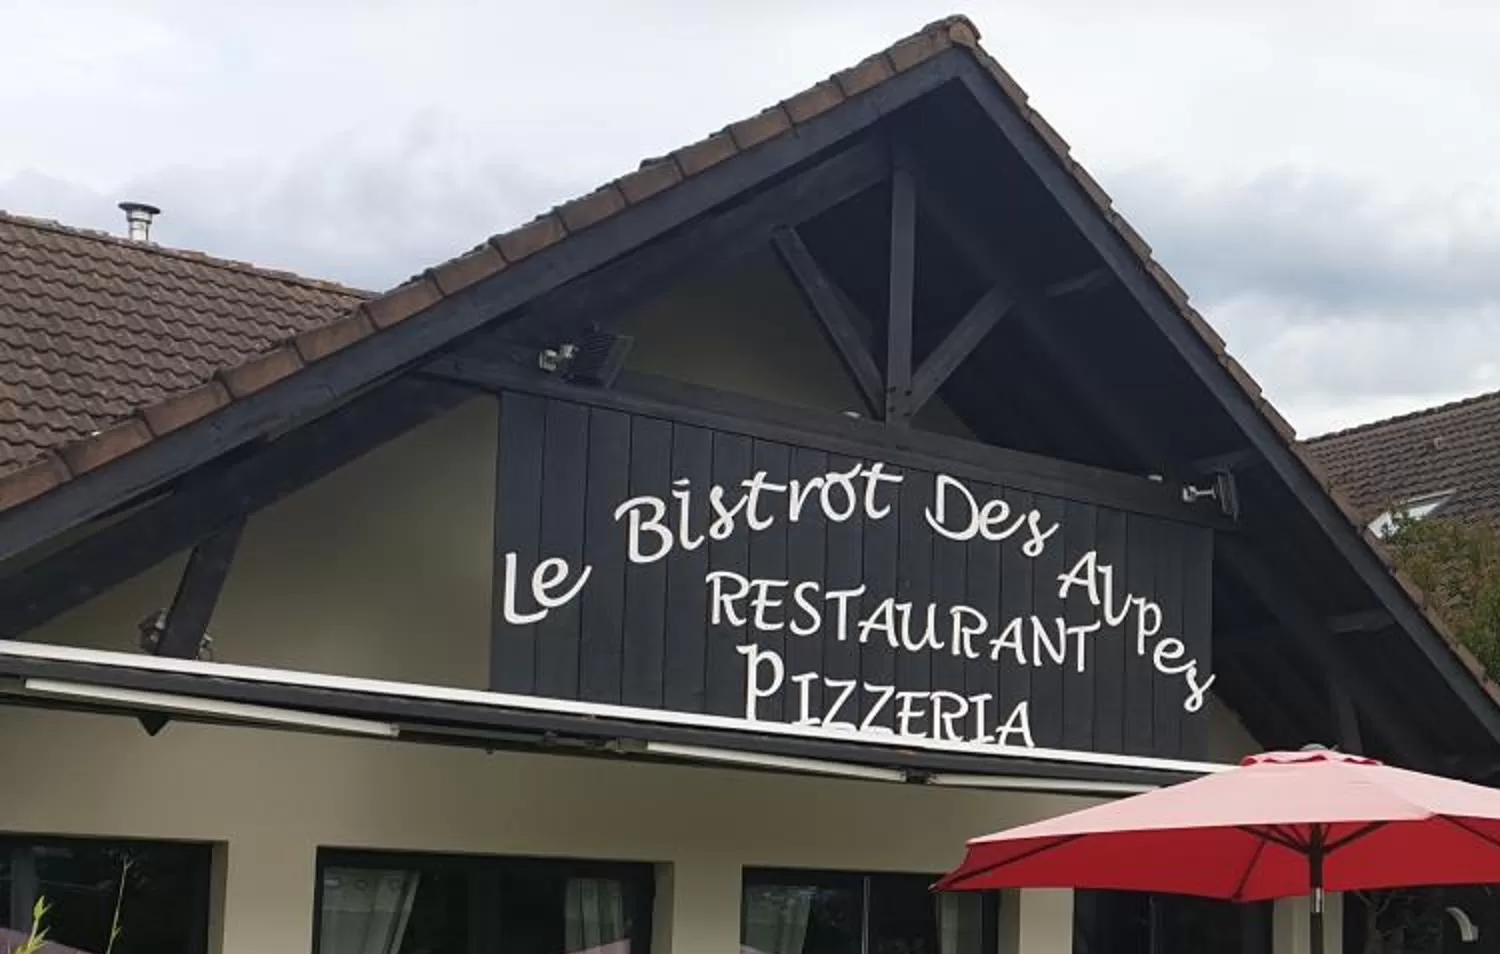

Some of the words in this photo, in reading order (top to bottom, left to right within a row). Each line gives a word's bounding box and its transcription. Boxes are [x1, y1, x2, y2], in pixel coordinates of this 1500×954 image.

[502, 551, 592, 625] Le
[614, 462, 903, 563] Bistrot
[925, 473, 1059, 556] Des
[1058, 550, 1215, 713] Alpes
[705, 570, 1101, 673] RESTAURANT
[736, 643, 1035, 748] PIZZERIA
